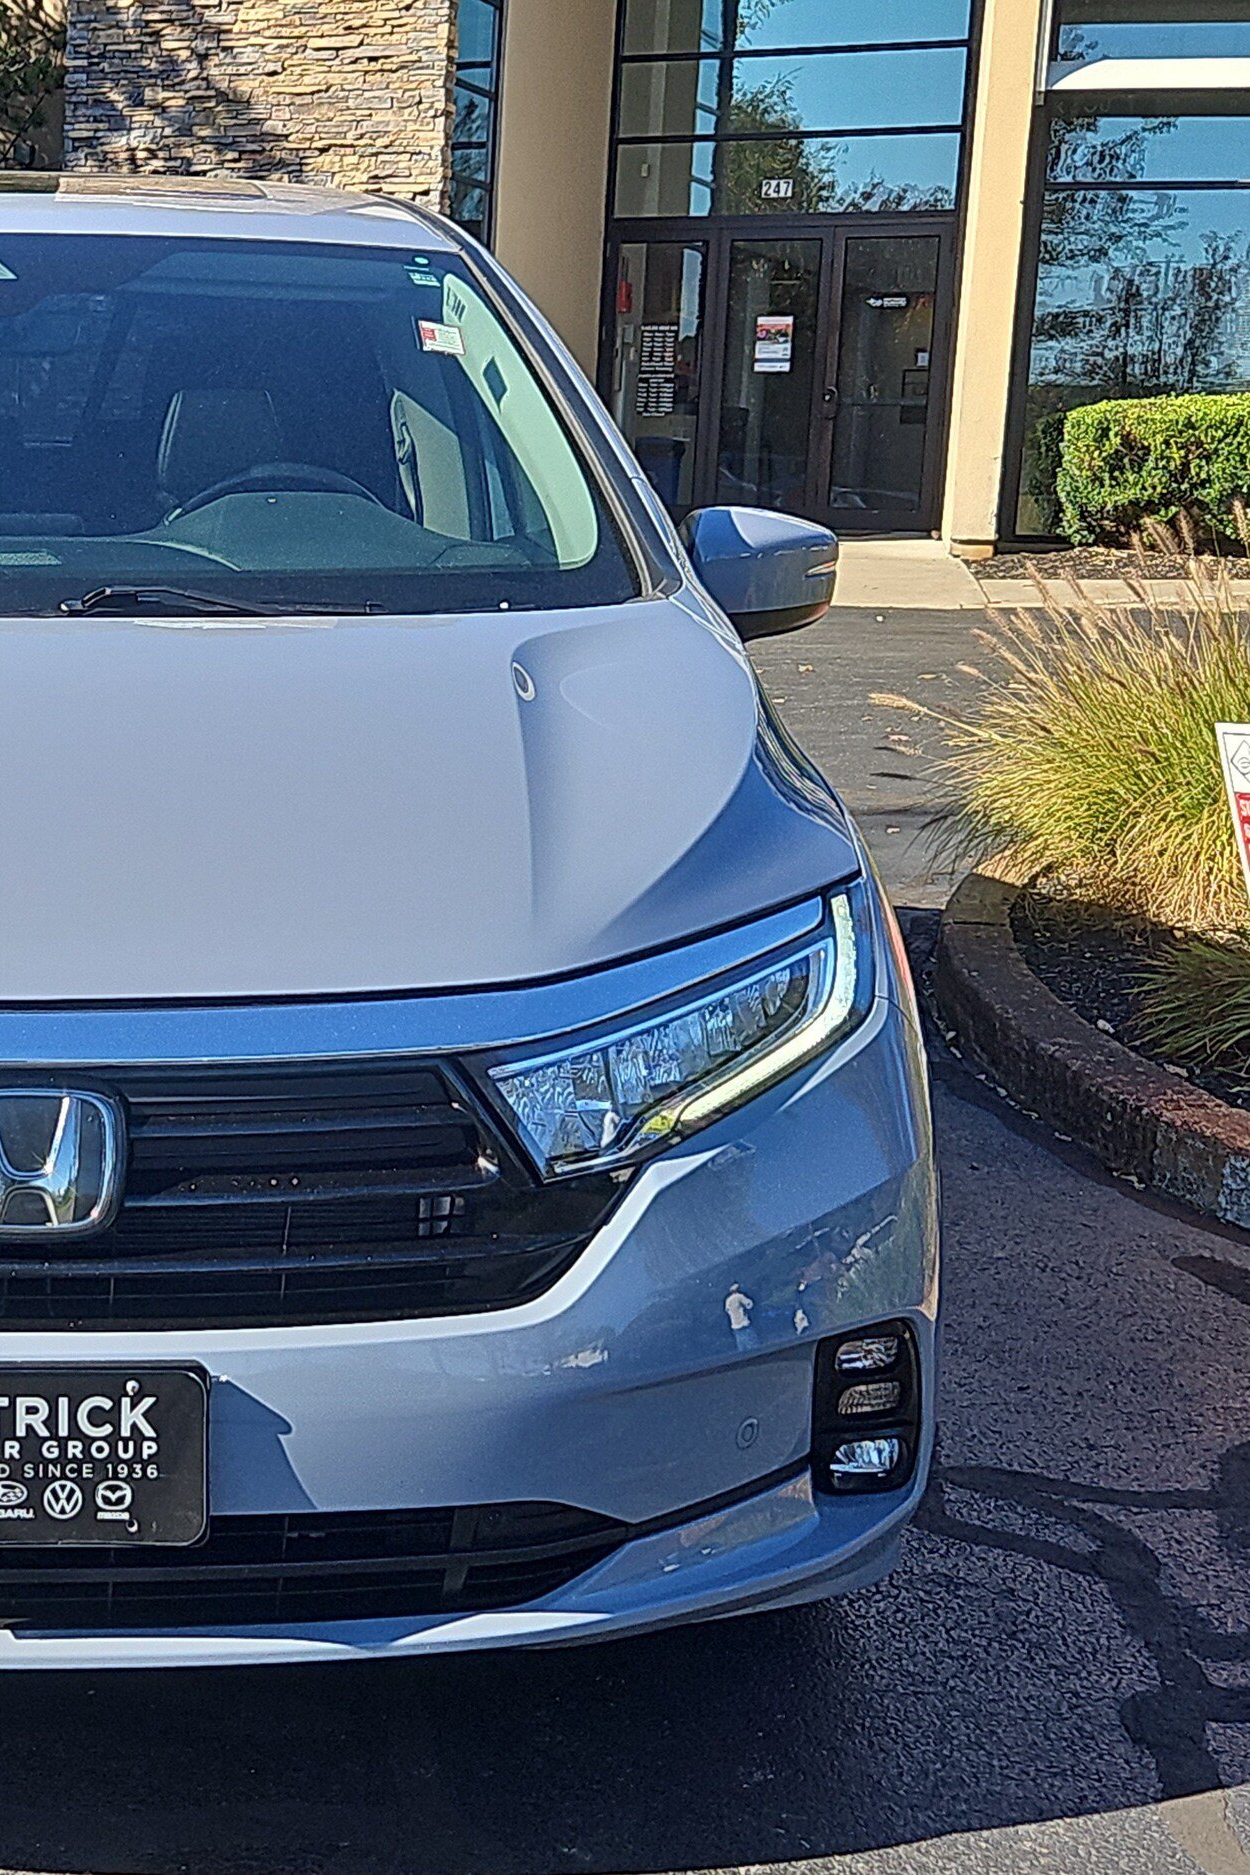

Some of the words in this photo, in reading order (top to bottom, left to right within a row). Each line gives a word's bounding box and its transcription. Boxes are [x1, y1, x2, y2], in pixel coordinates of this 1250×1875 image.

[763, 180, 791, 196] 247
[41, 1440, 159, 1460] GROUP
[23, 1463, 94, 1479] SINCE
[106, 1463, 159, 1479] 1936
